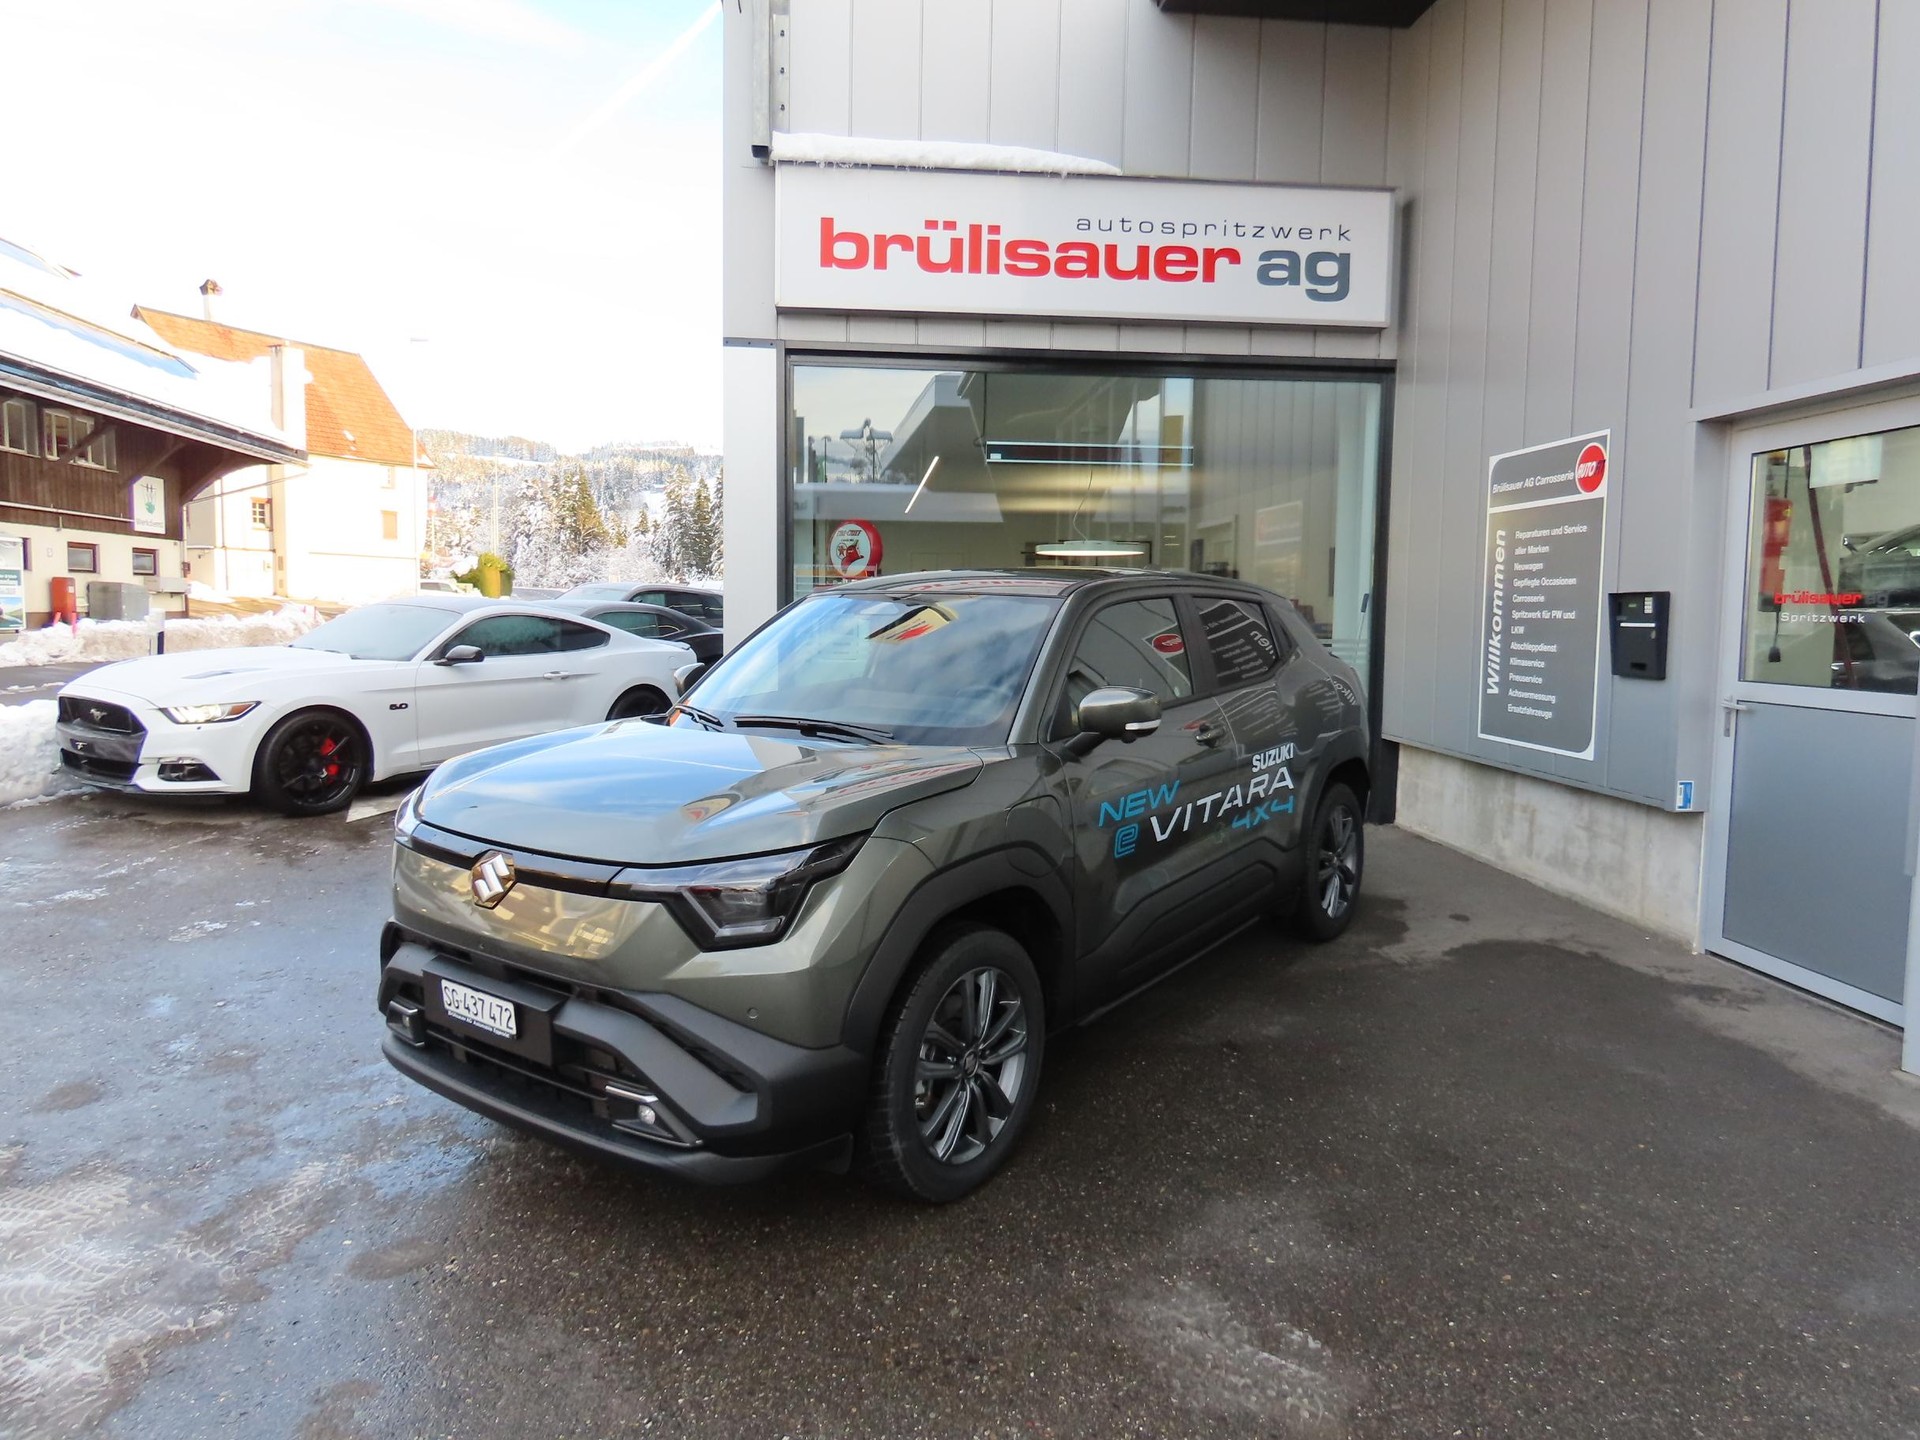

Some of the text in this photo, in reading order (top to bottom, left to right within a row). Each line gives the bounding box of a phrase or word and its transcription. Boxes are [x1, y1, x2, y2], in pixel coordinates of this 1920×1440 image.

[1076, 214, 1352, 242] autospritzwerk
[820, 217, 1351, 302] brülisauer ag
[1524, 478, 1535, 488] AG
[1515, 524, 1588, 539] Reparaturen und Service
[1527, 545, 1550, 554] Marken
[1540, 577, 1577, 586] Occasionen
[1486, 529, 1506, 694] Willkommen
[1551, 610, 1562, 619] PW
[1562, 610, 1576, 619] und
[1780, 612, 1865, 624] Spritzwerk
[1511, 626, 1525, 635] LKW
[1251, 742, 1294, 773] SUZUKI
[1098, 779, 1180, 827] NEW
[1150, 766, 1294, 842] VITARA
